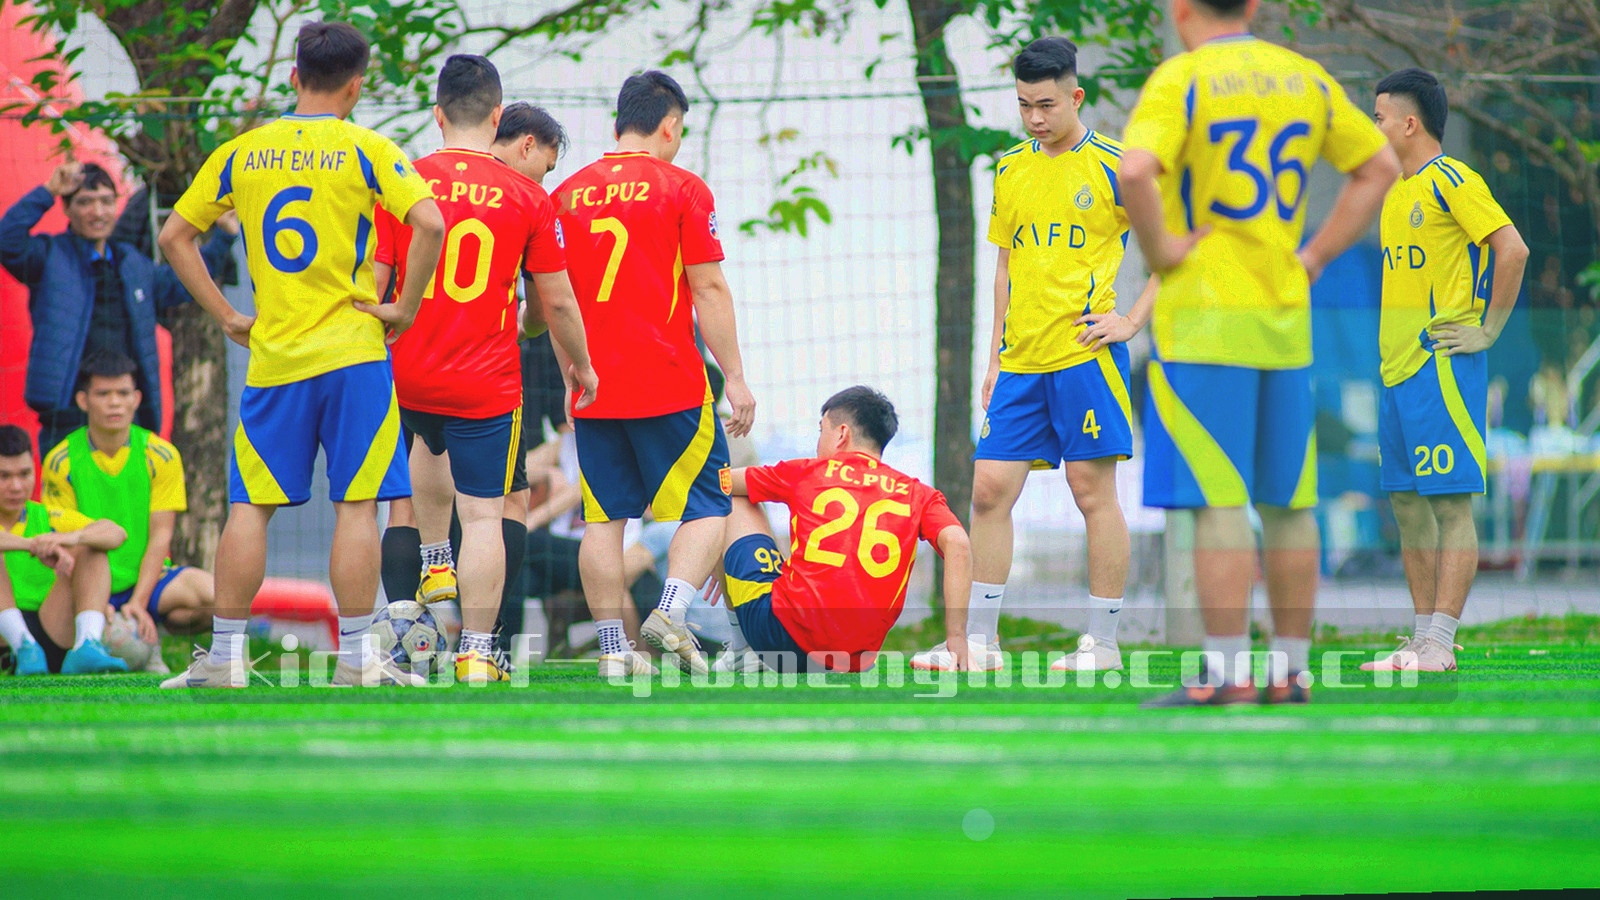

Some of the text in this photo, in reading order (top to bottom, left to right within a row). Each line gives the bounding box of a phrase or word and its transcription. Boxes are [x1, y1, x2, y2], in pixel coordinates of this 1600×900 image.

[243, 149, 347, 172] ANH EM WF
[1209, 118, 1311, 222] 36
[424, 178, 504, 209] C.PU2
[571, 181, 650, 209] FC.PU2
[262, 185, 319, 273] 6
[590, 216, 629, 302] 7
[423, 217, 495, 303] 0
[1082, 408, 1101, 439] 4
[1414, 443, 1454, 477] 20
[804, 487, 911, 579] 26
